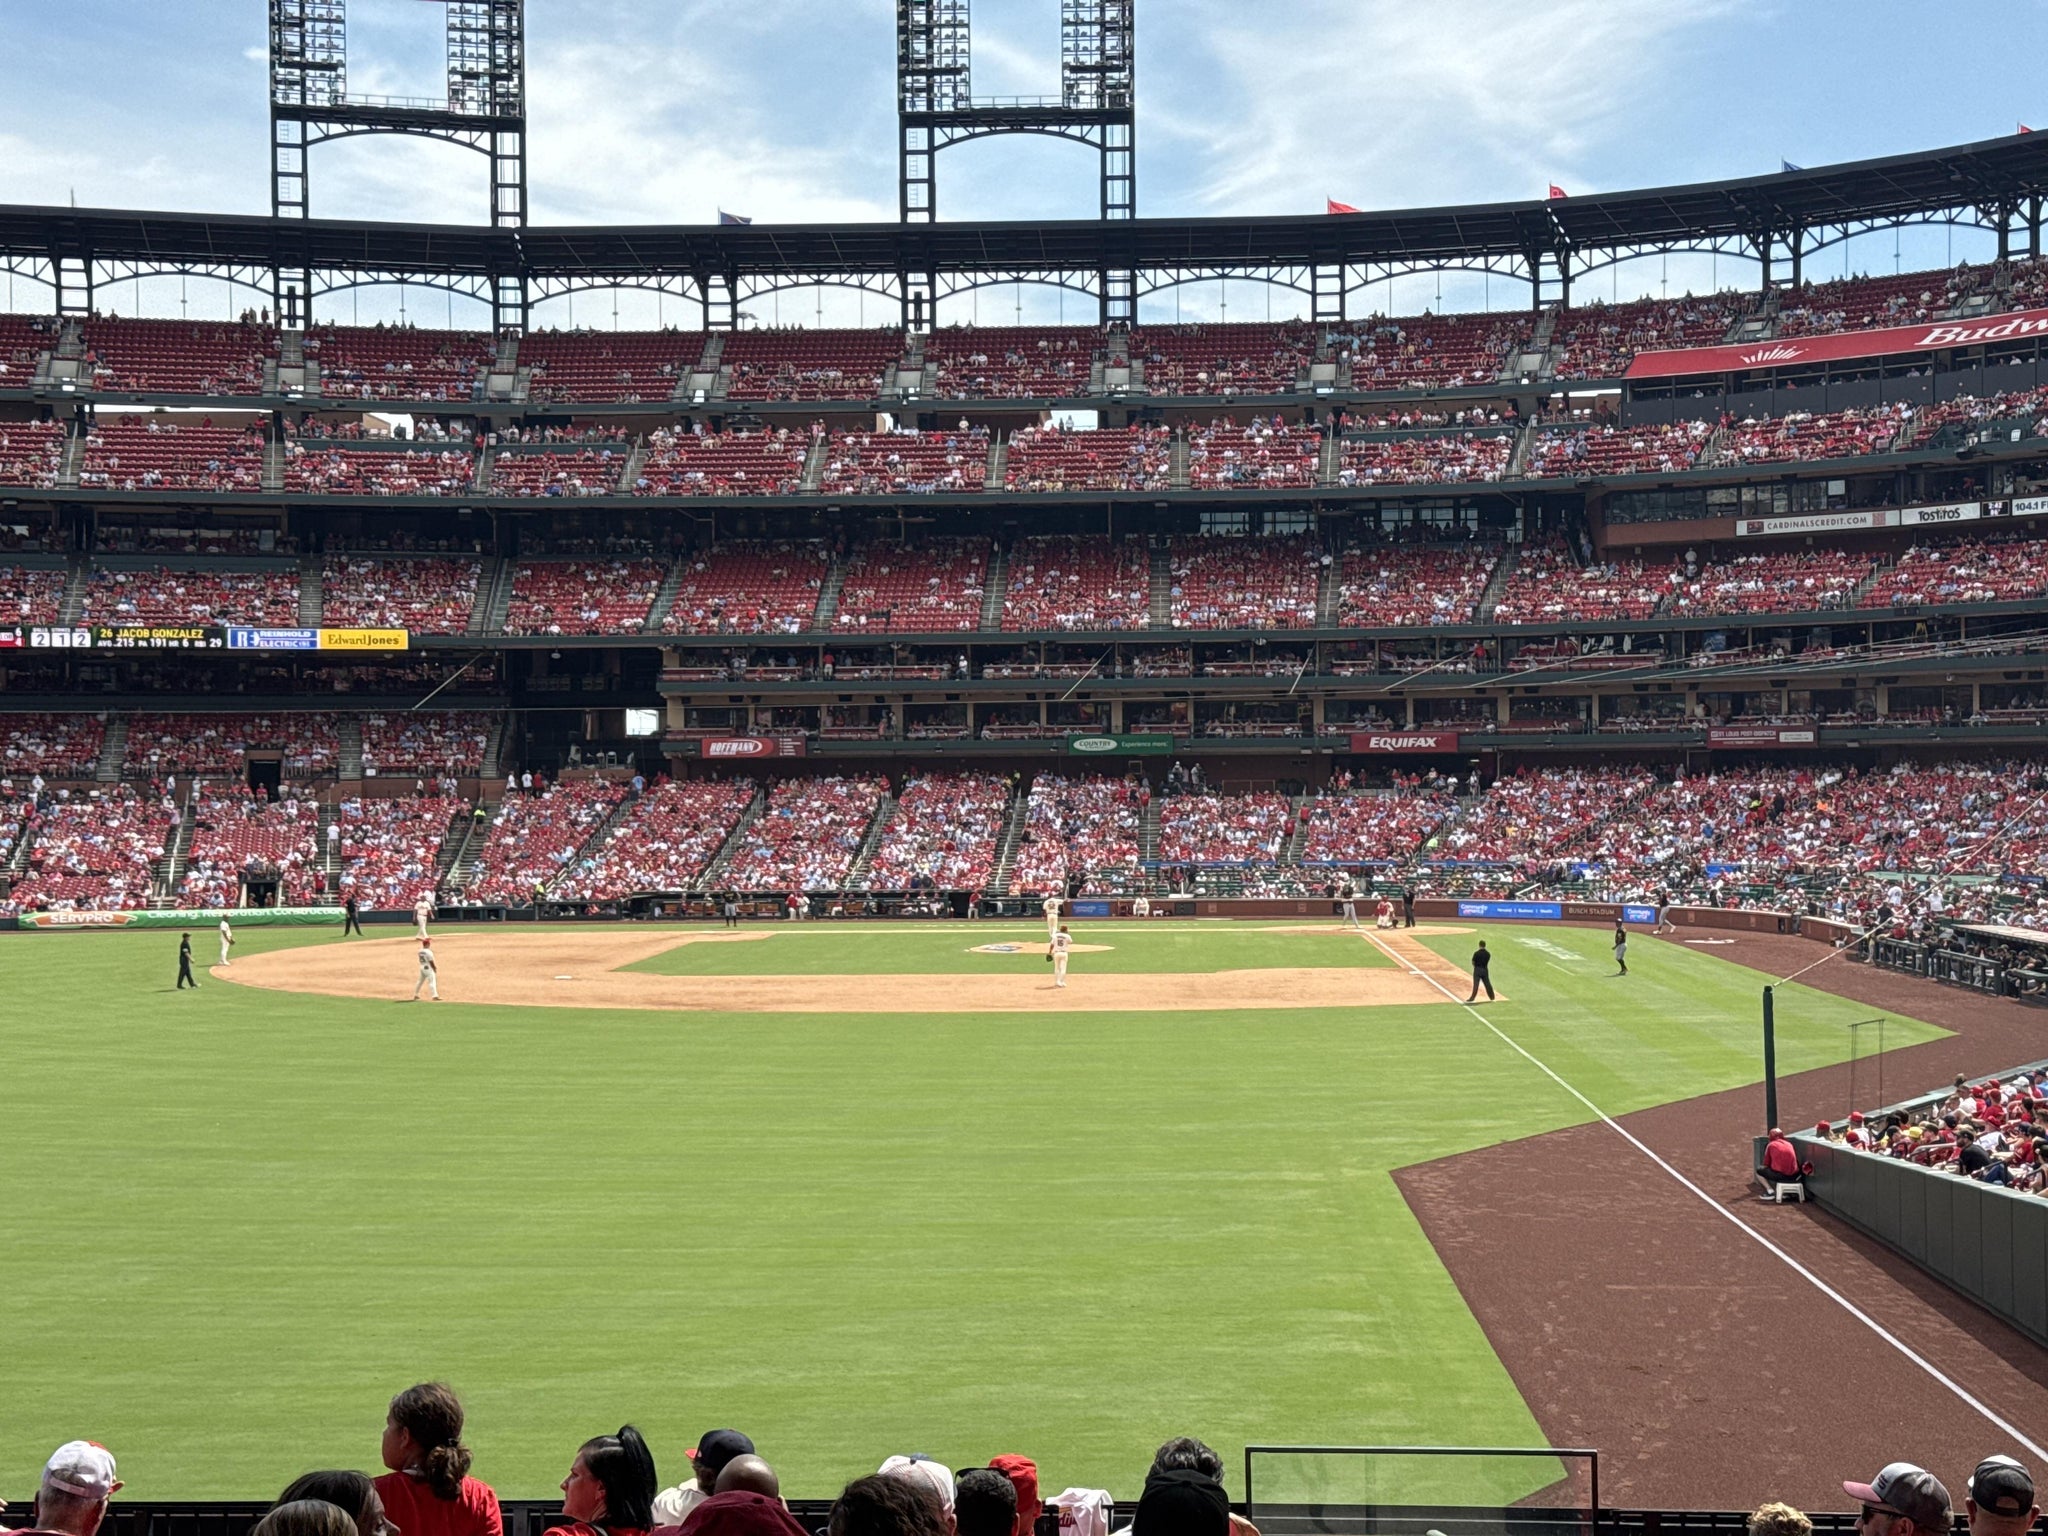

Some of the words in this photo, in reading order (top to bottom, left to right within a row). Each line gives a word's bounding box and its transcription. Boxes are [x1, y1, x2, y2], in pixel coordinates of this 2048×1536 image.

[2015, 501, 2039, 511] 104.1
[1767, 516, 1867, 530] CARDINALSCREDIT.COM
[15, 627, 22, 637] 6
[100, 628, 113, 638] 26
[116, 628, 150, 638] JACOB
[152, 628, 204, 639] GONZALEZ
[260, 630, 312, 638] REINHOLD
[37, 634, 45, 646] 2
[59, 634, 65, 646] 1
[78, 634, 86, 646] 2
[113, 638, 135, 647] .215
[150, 638, 167, 647] 191
[182, 638, 190, 647] 6
[209, 638, 222, 648] 29
[260, 640, 298, 648] ELECTRIC
[710, 741, 756, 752] HOFFMANN
[1121, 741, 1151, 749] Experience
[1369, 736, 1437, 751] EQUIFAX
[50, 913, 114, 924] SERVPRO
